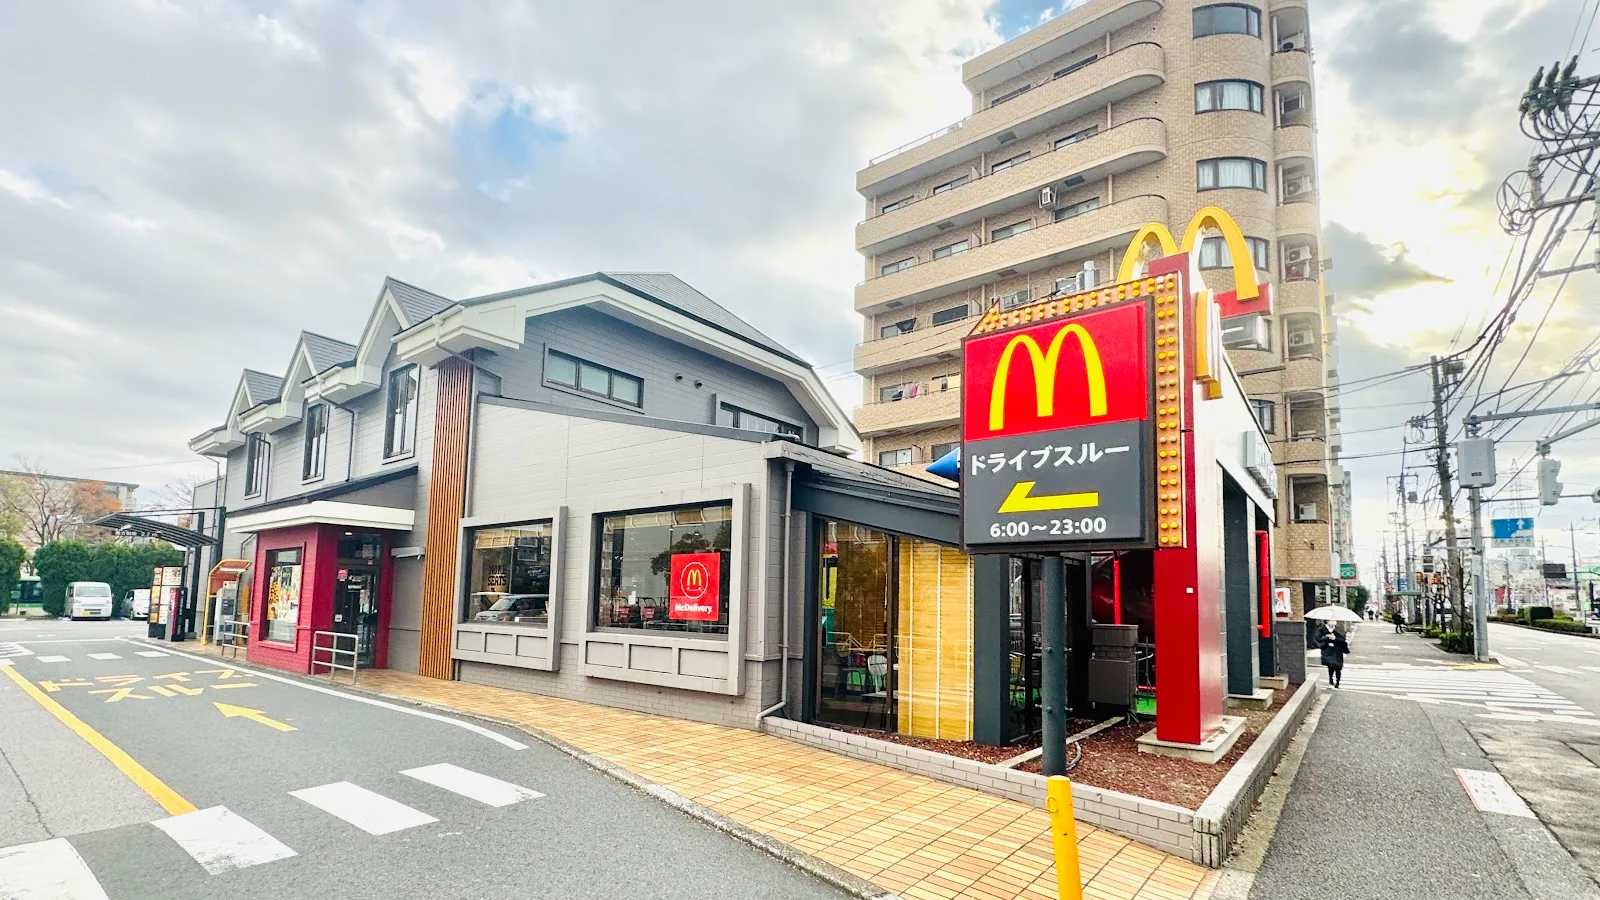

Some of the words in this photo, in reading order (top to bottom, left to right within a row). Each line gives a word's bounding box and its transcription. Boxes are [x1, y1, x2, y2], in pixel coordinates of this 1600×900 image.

[971, 441, 1130, 476] ドライブスルー
[674, 603, 713, 615] McDelivery
[38, 669, 256, 693] ドライブ
[87, 682, 259, 703] スルー
